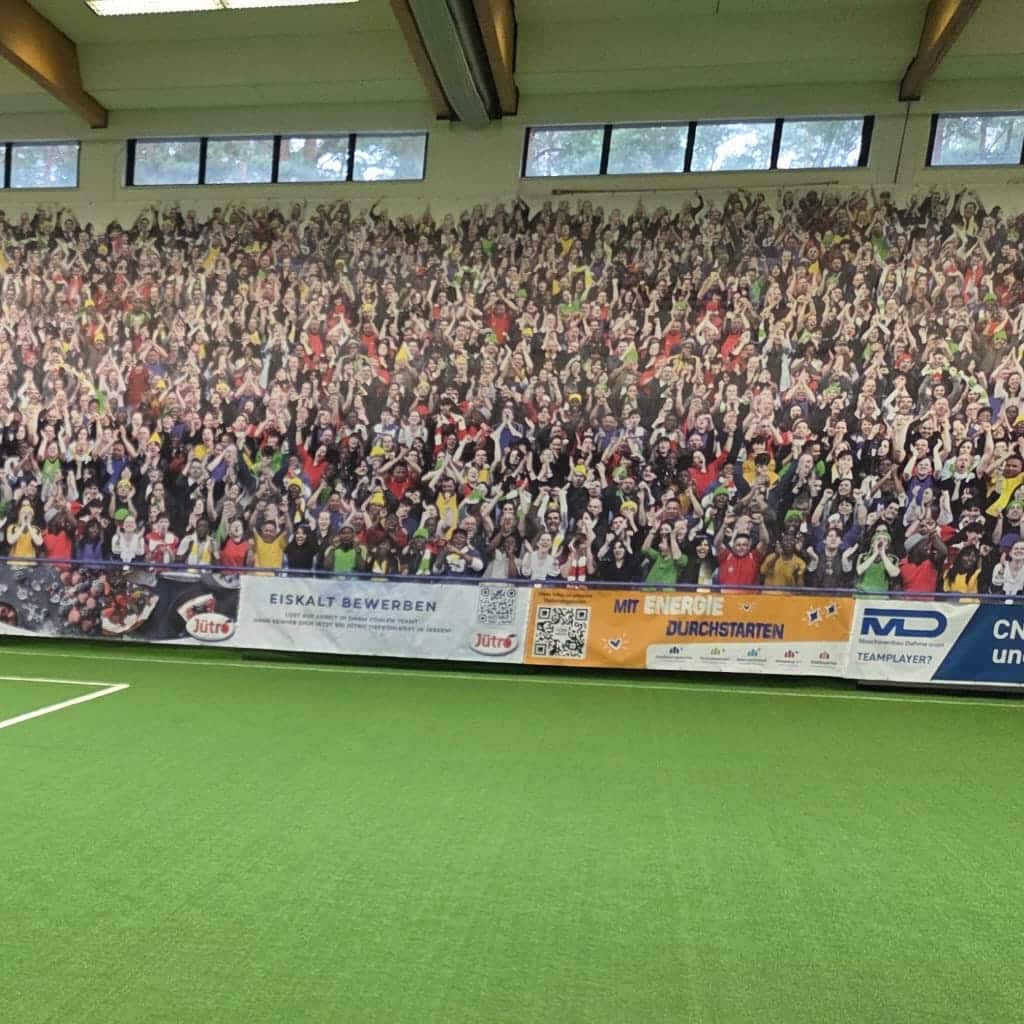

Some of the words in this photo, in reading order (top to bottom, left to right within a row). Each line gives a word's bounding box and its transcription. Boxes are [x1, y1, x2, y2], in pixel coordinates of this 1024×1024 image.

[269, 593, 334, 608] EISKALT
[341, 597, 437, 613] BEWERBEN
[614, 598, 640, 614] MIT
[643, 596, 725, 616] ENERGIE
[193, 617, 231, 634] Jütro
[666, 620, 785, 640] DURCHSTARTEN
[861, 608, 948, 638] MD
[474, 633, 514, 649] Jütro
[857, 652, 933, 664] TEAMPLAYER?
[992, 649, 1024, 665] un
